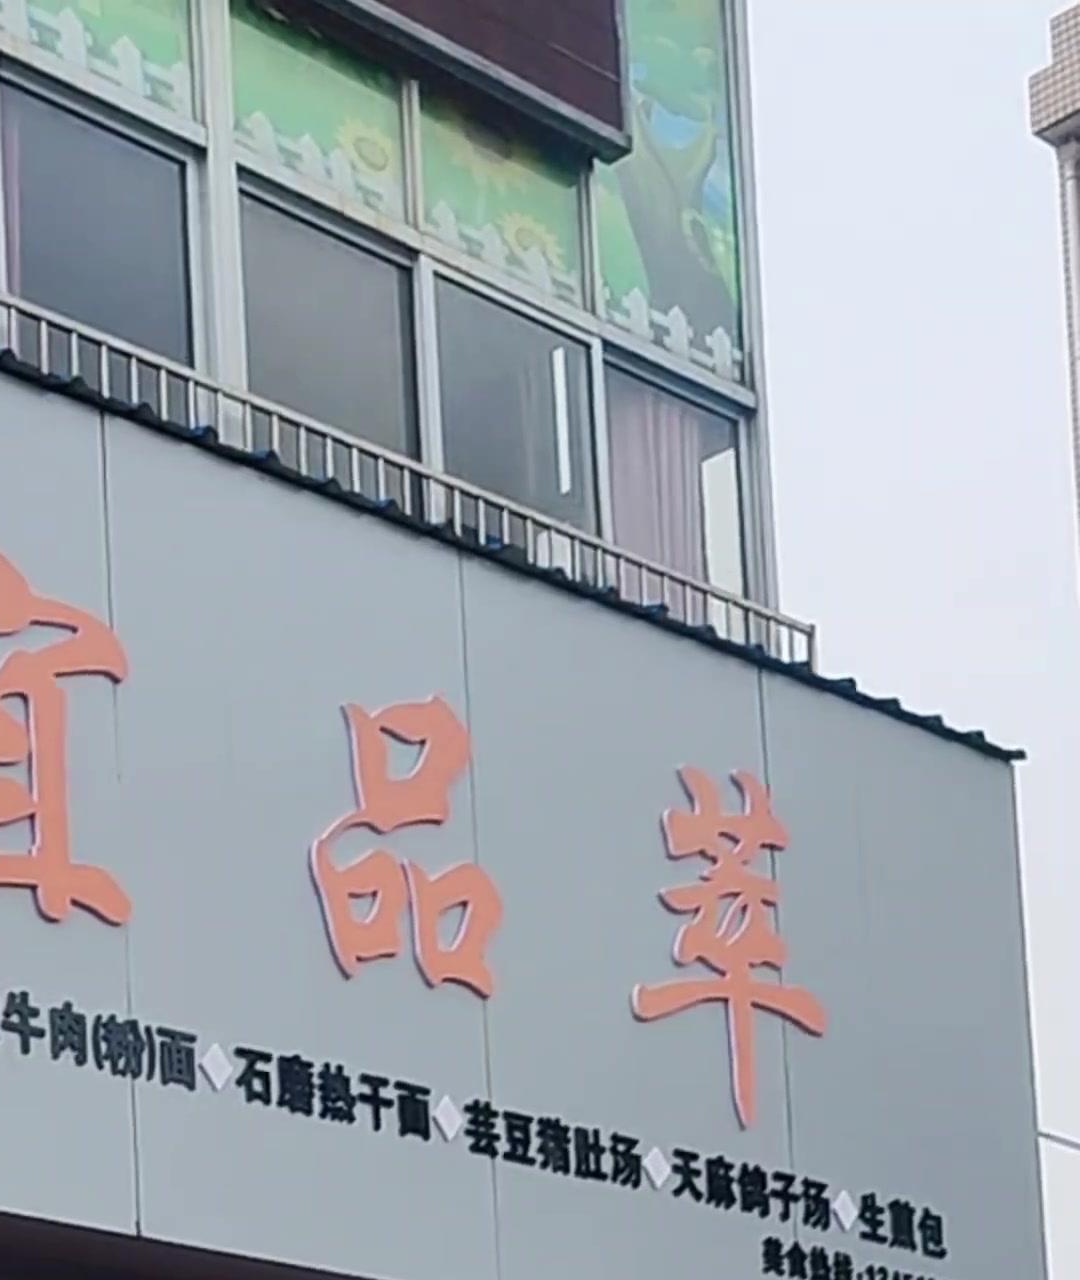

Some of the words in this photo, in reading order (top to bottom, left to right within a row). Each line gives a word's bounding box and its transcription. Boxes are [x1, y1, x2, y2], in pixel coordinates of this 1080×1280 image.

[233, 1046, 431, 1142] 石磨热干面
[463, 1098, 642, 1190] 芸豆猪肚汤
[671, 1148, 831, 1232] 天麻鸽子汤
[857, 1192, 948, 1260] 生煎包
